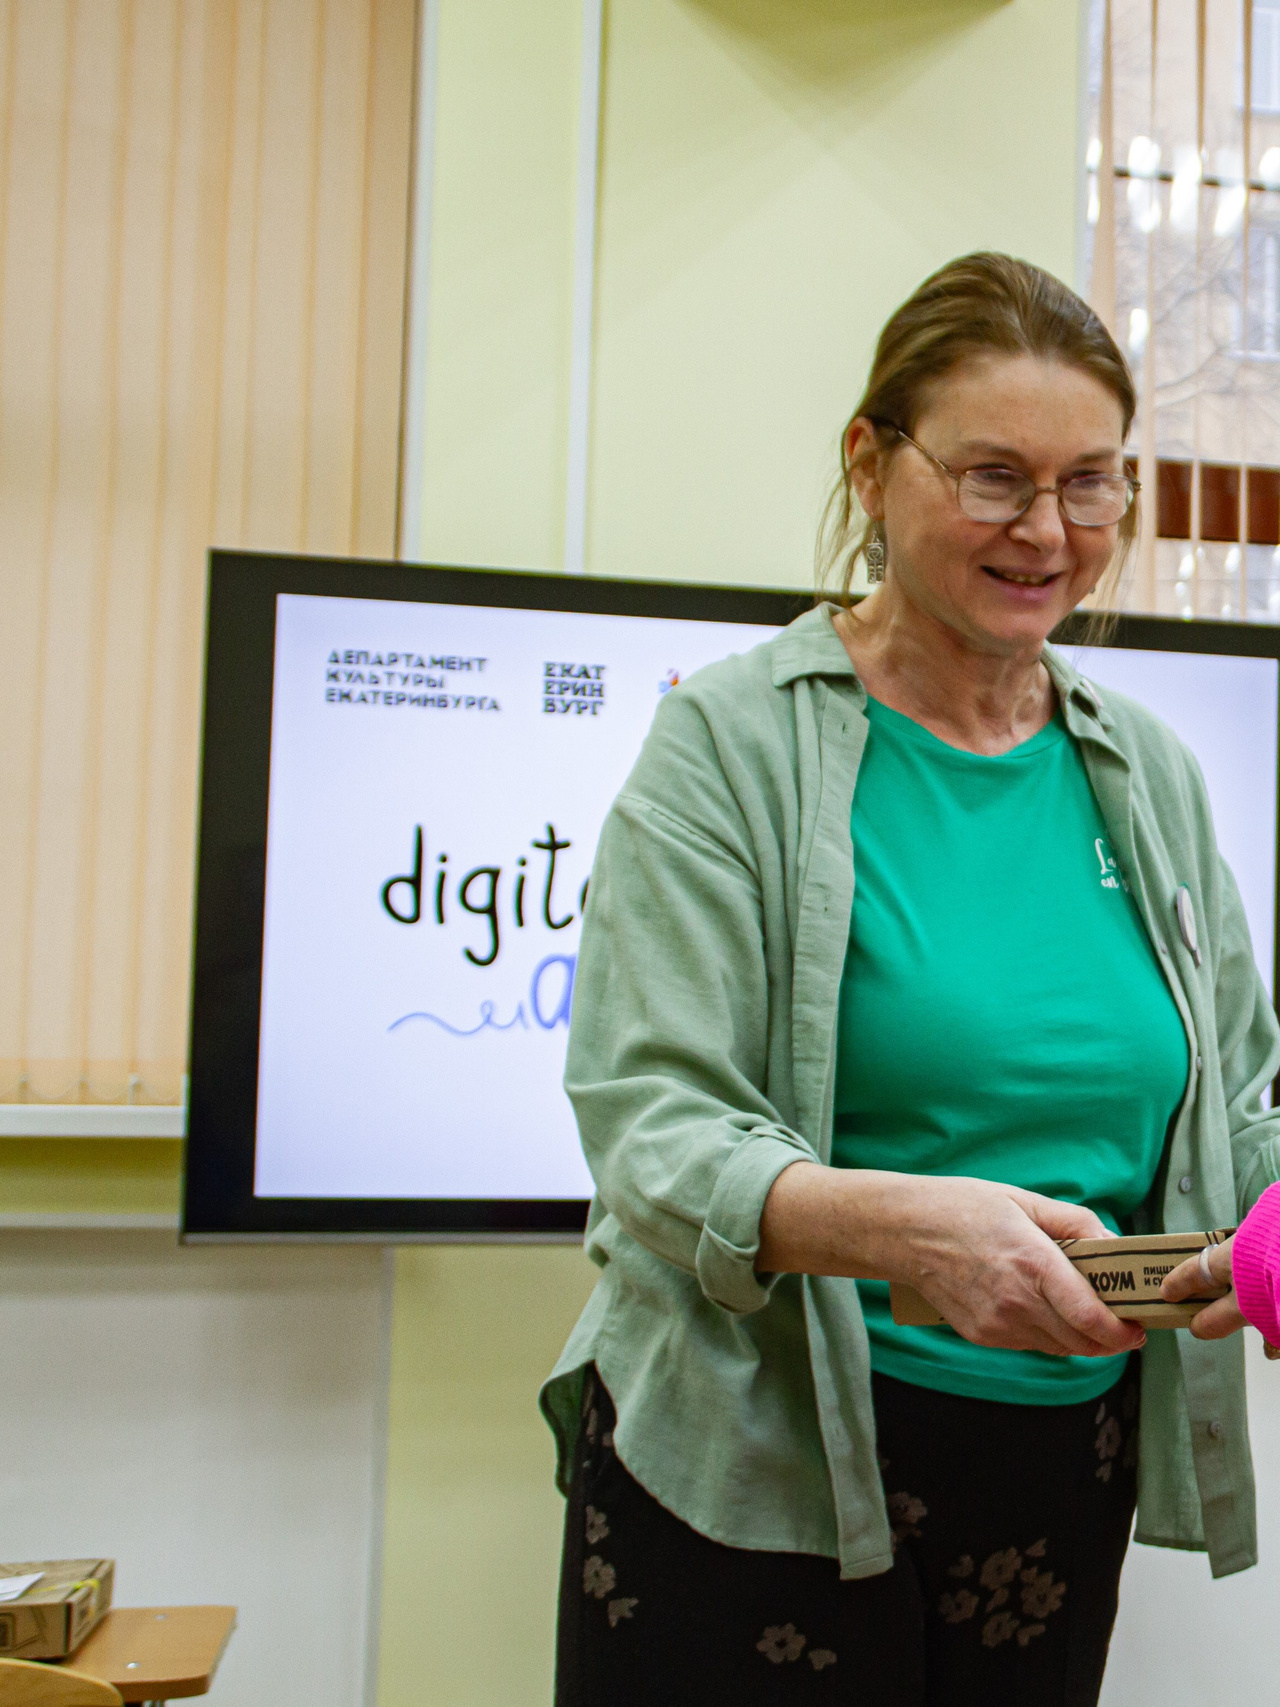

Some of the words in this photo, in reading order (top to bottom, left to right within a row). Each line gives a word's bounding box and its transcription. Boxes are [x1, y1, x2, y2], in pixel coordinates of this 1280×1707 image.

[327, 649, 488, 673] ДЕПАРТАМЕНТ
[543, 661, 606, 680] ЕКАТ
[325, 668, 446, 689] КУЛЬТУРЫ
[543, 679, 605, 699] ЕРИН
[324, 687, 502, 712] ЕКАТЕРИНБУРГА
[542, 697, 606, 716] БУРГ
[380, 823, 592, 966] digit
